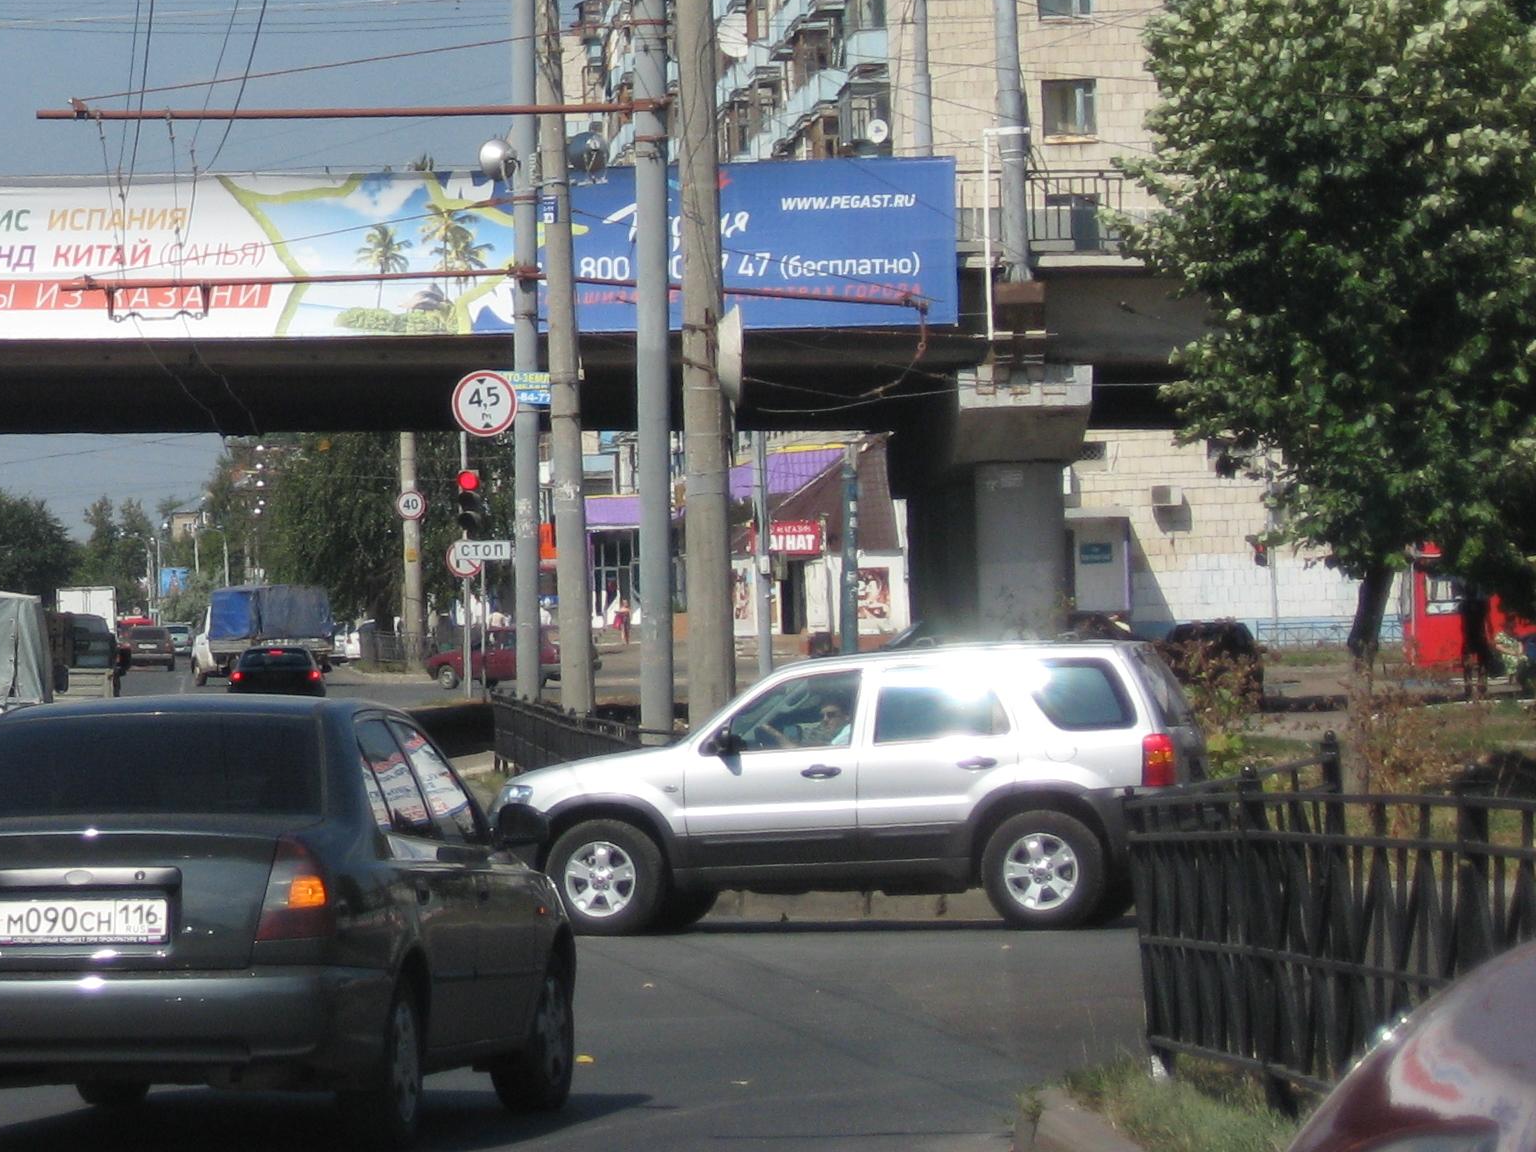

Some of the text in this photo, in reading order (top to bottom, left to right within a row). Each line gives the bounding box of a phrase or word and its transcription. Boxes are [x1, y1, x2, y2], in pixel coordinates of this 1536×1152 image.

[781, 194, 916, 211] WWW.PEGAST.RU
[47, 207, 188, 232] ИСПАНИЯ
[52, 237, 152, 268] КИТАЙ
[780, 251, 921, 279] (бесплатно)
[35, 281, 88, 310] ИЗ
[468, 385, 501, 409] 4,5
[404, 498, 419, 510] 40
[460, 544, 504, 557] СТОП
